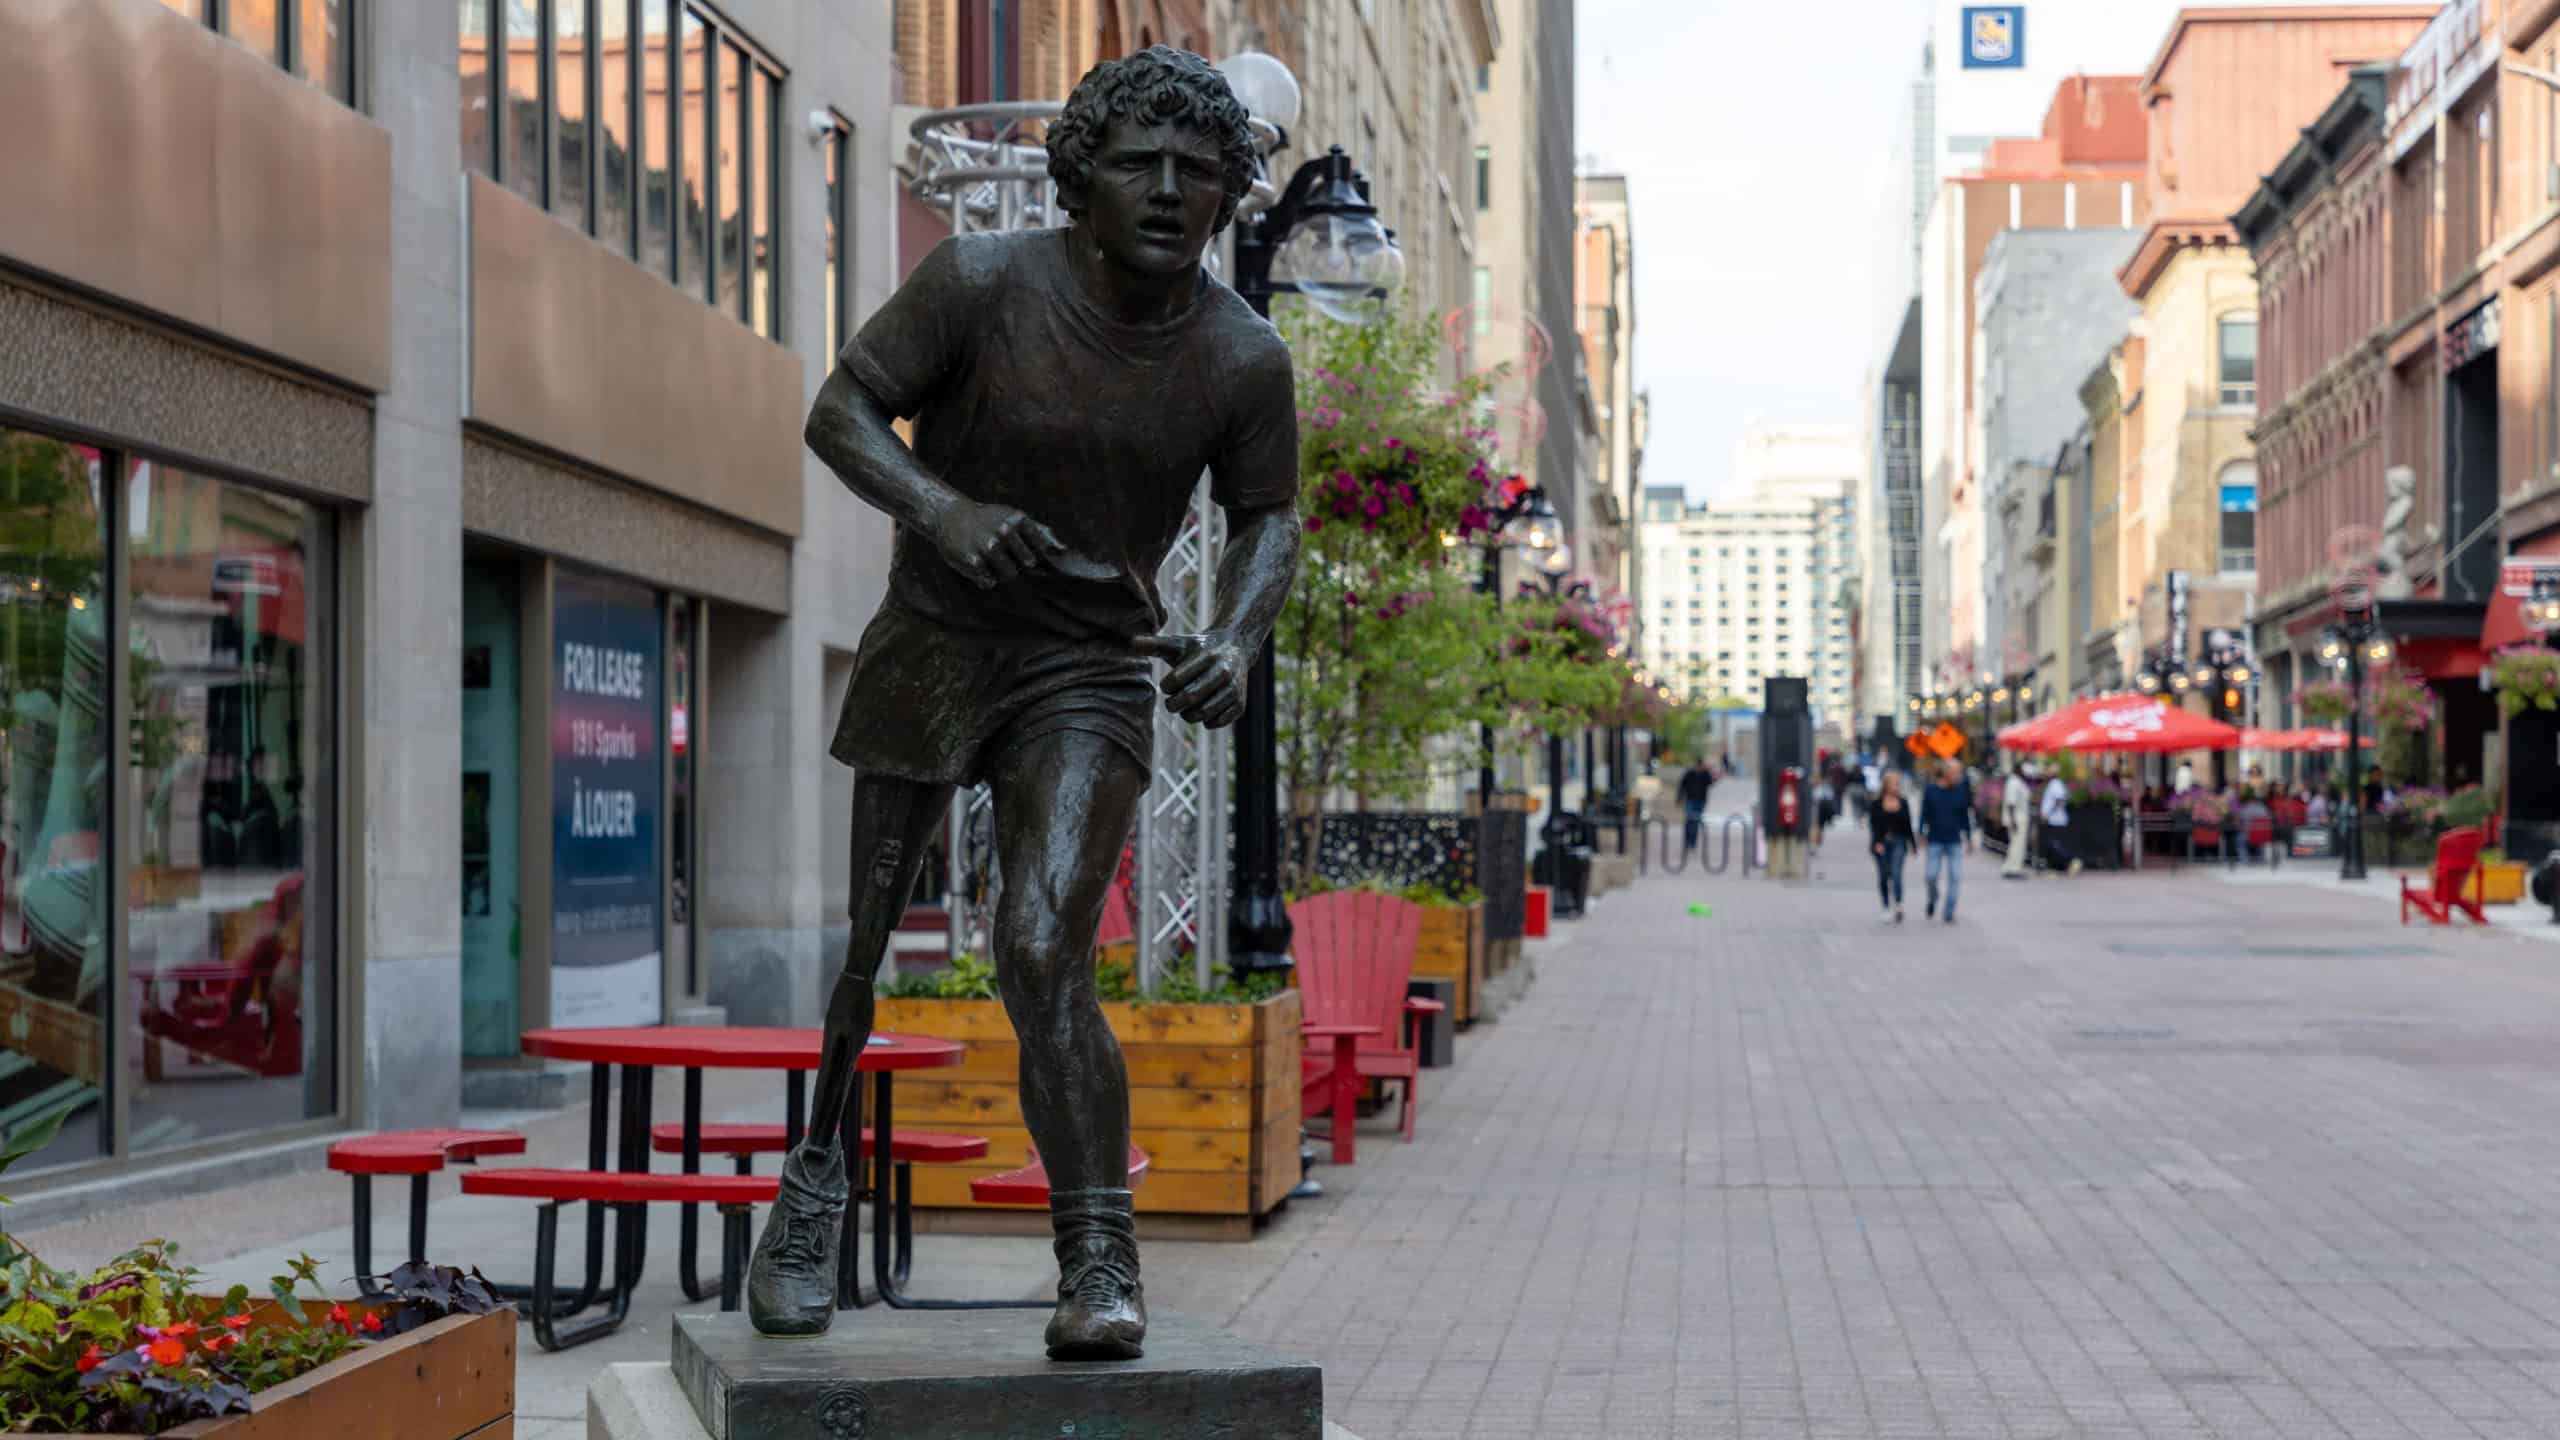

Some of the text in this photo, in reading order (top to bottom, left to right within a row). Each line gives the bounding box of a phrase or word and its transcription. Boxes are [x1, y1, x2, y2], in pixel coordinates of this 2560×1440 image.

[564, 642, 643, 700] FOR LEASE
[573, 719, 593, 757] 191
[596, 720, 637, 766] Sparks
[572, 776, 636, 838] À LOUER
